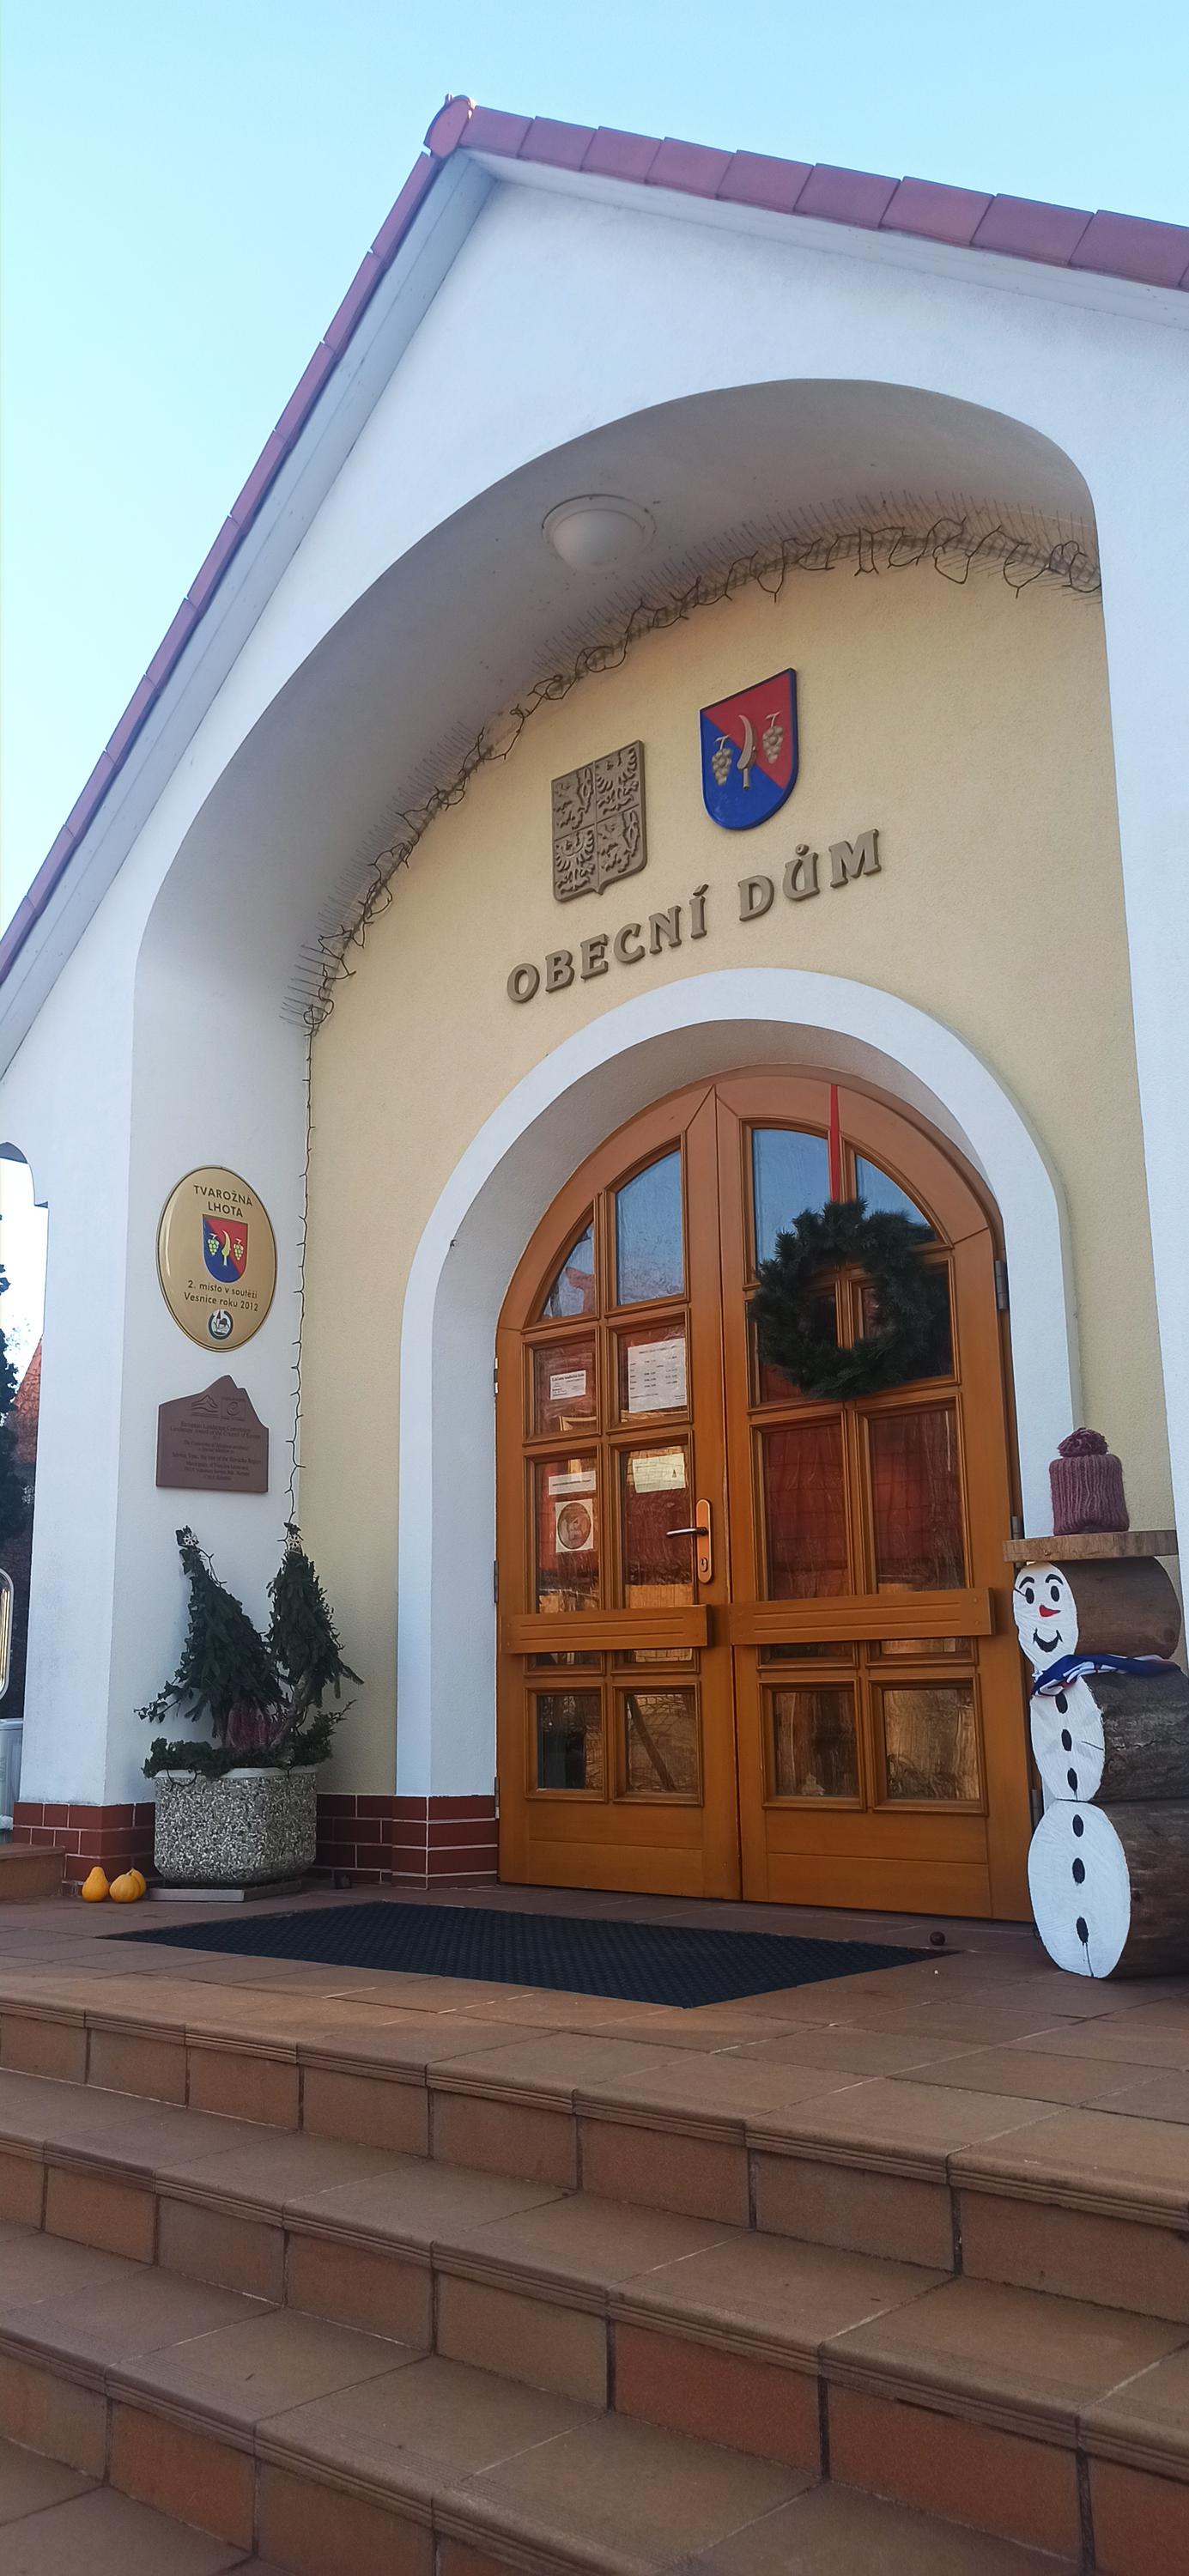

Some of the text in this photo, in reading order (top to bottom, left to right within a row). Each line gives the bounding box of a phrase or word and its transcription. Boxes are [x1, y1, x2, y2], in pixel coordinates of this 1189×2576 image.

[507, 828, 883, 1004] OBECNÍ DŮM
[208, 1201, 243, 1217] LHOTA
[184, 1291, 258, 1312] Vesnice roku 2012
